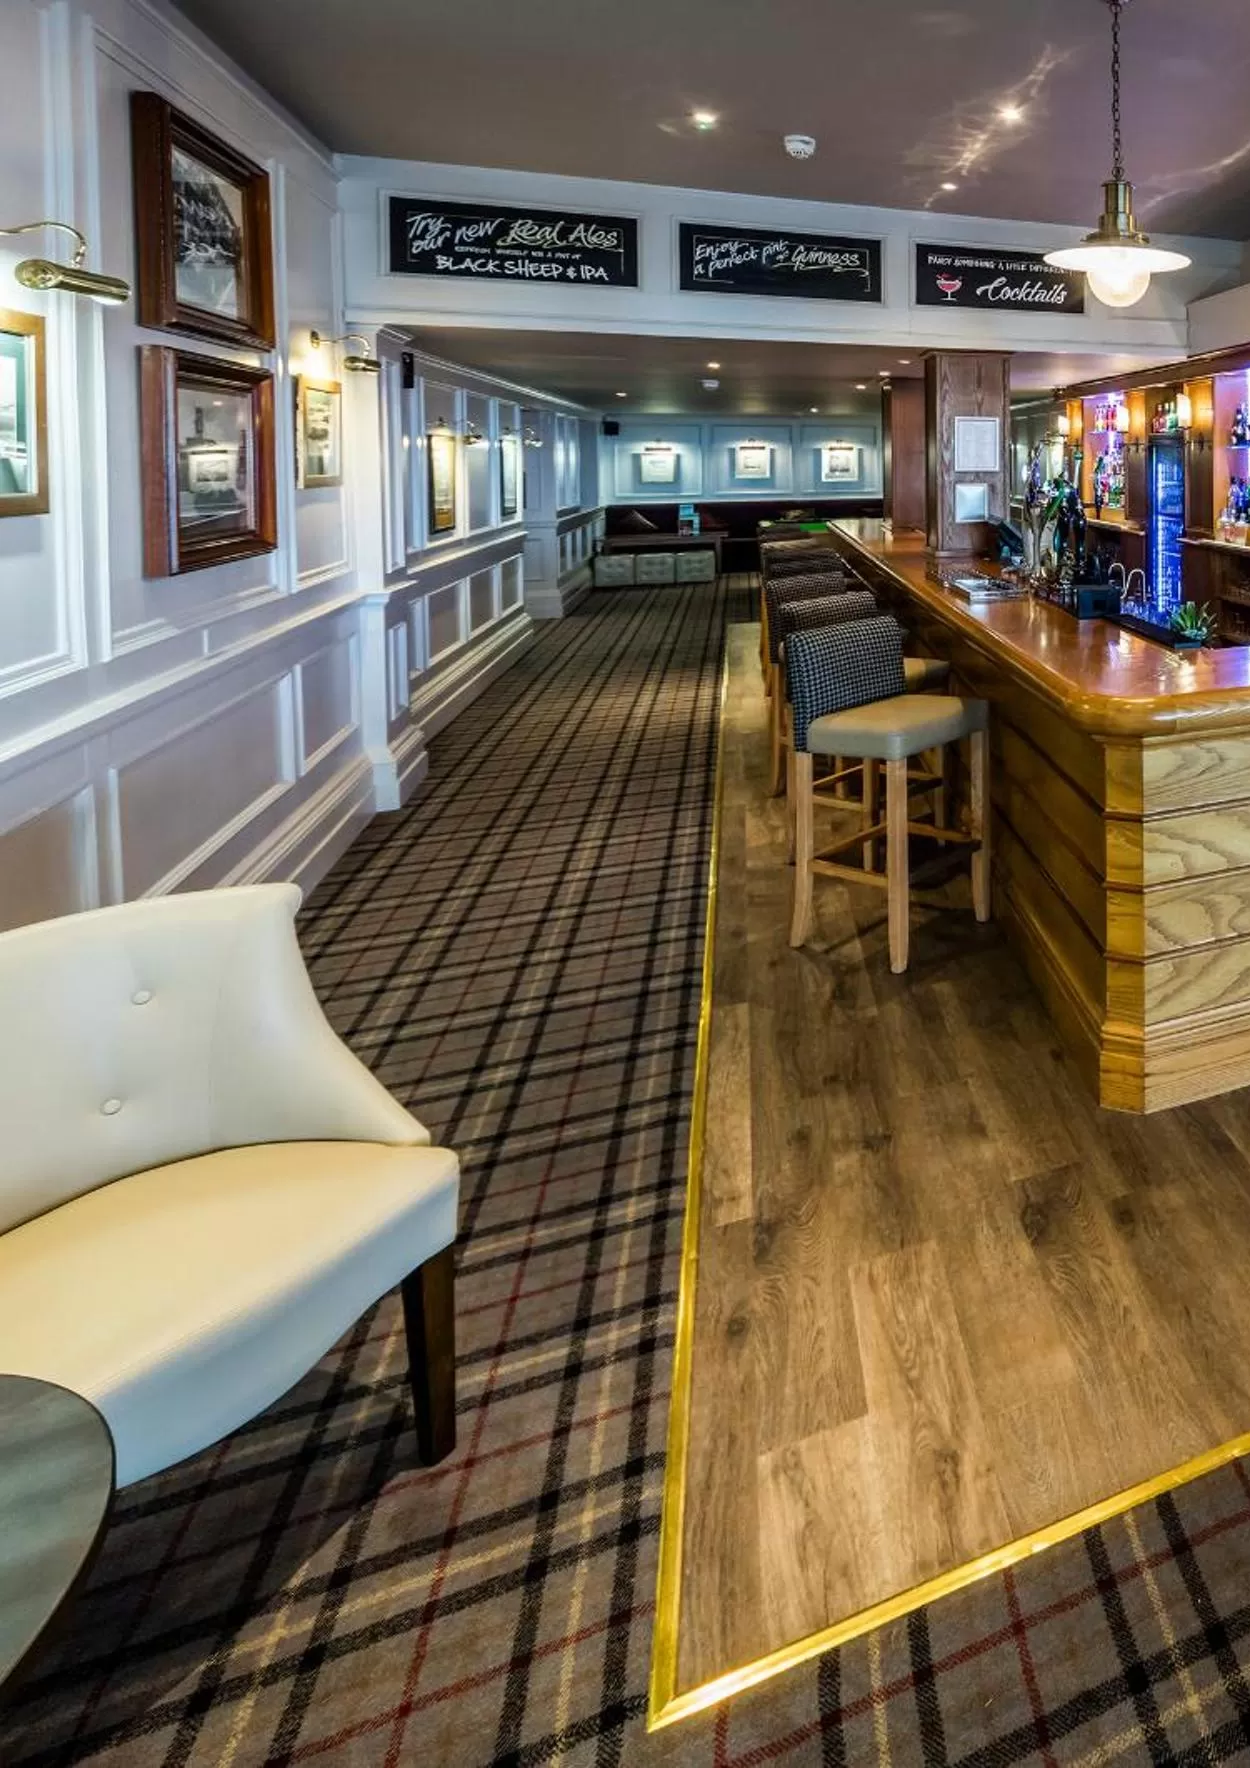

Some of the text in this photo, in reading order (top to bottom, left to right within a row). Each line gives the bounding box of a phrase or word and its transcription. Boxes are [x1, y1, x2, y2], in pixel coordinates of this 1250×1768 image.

[406, 212, 452, 239] Try
[412, 218, 618, 253] our new Real Ales
[694, 240, 789, 278] a perfect pint
[695, 241, 749, 261] Enjoy
[791, 246, 860, 272] Guinness
[435, 254, 609, 281] BLACK SHEEP & IPA
[976, 276, 1067, 304] Cocktails
